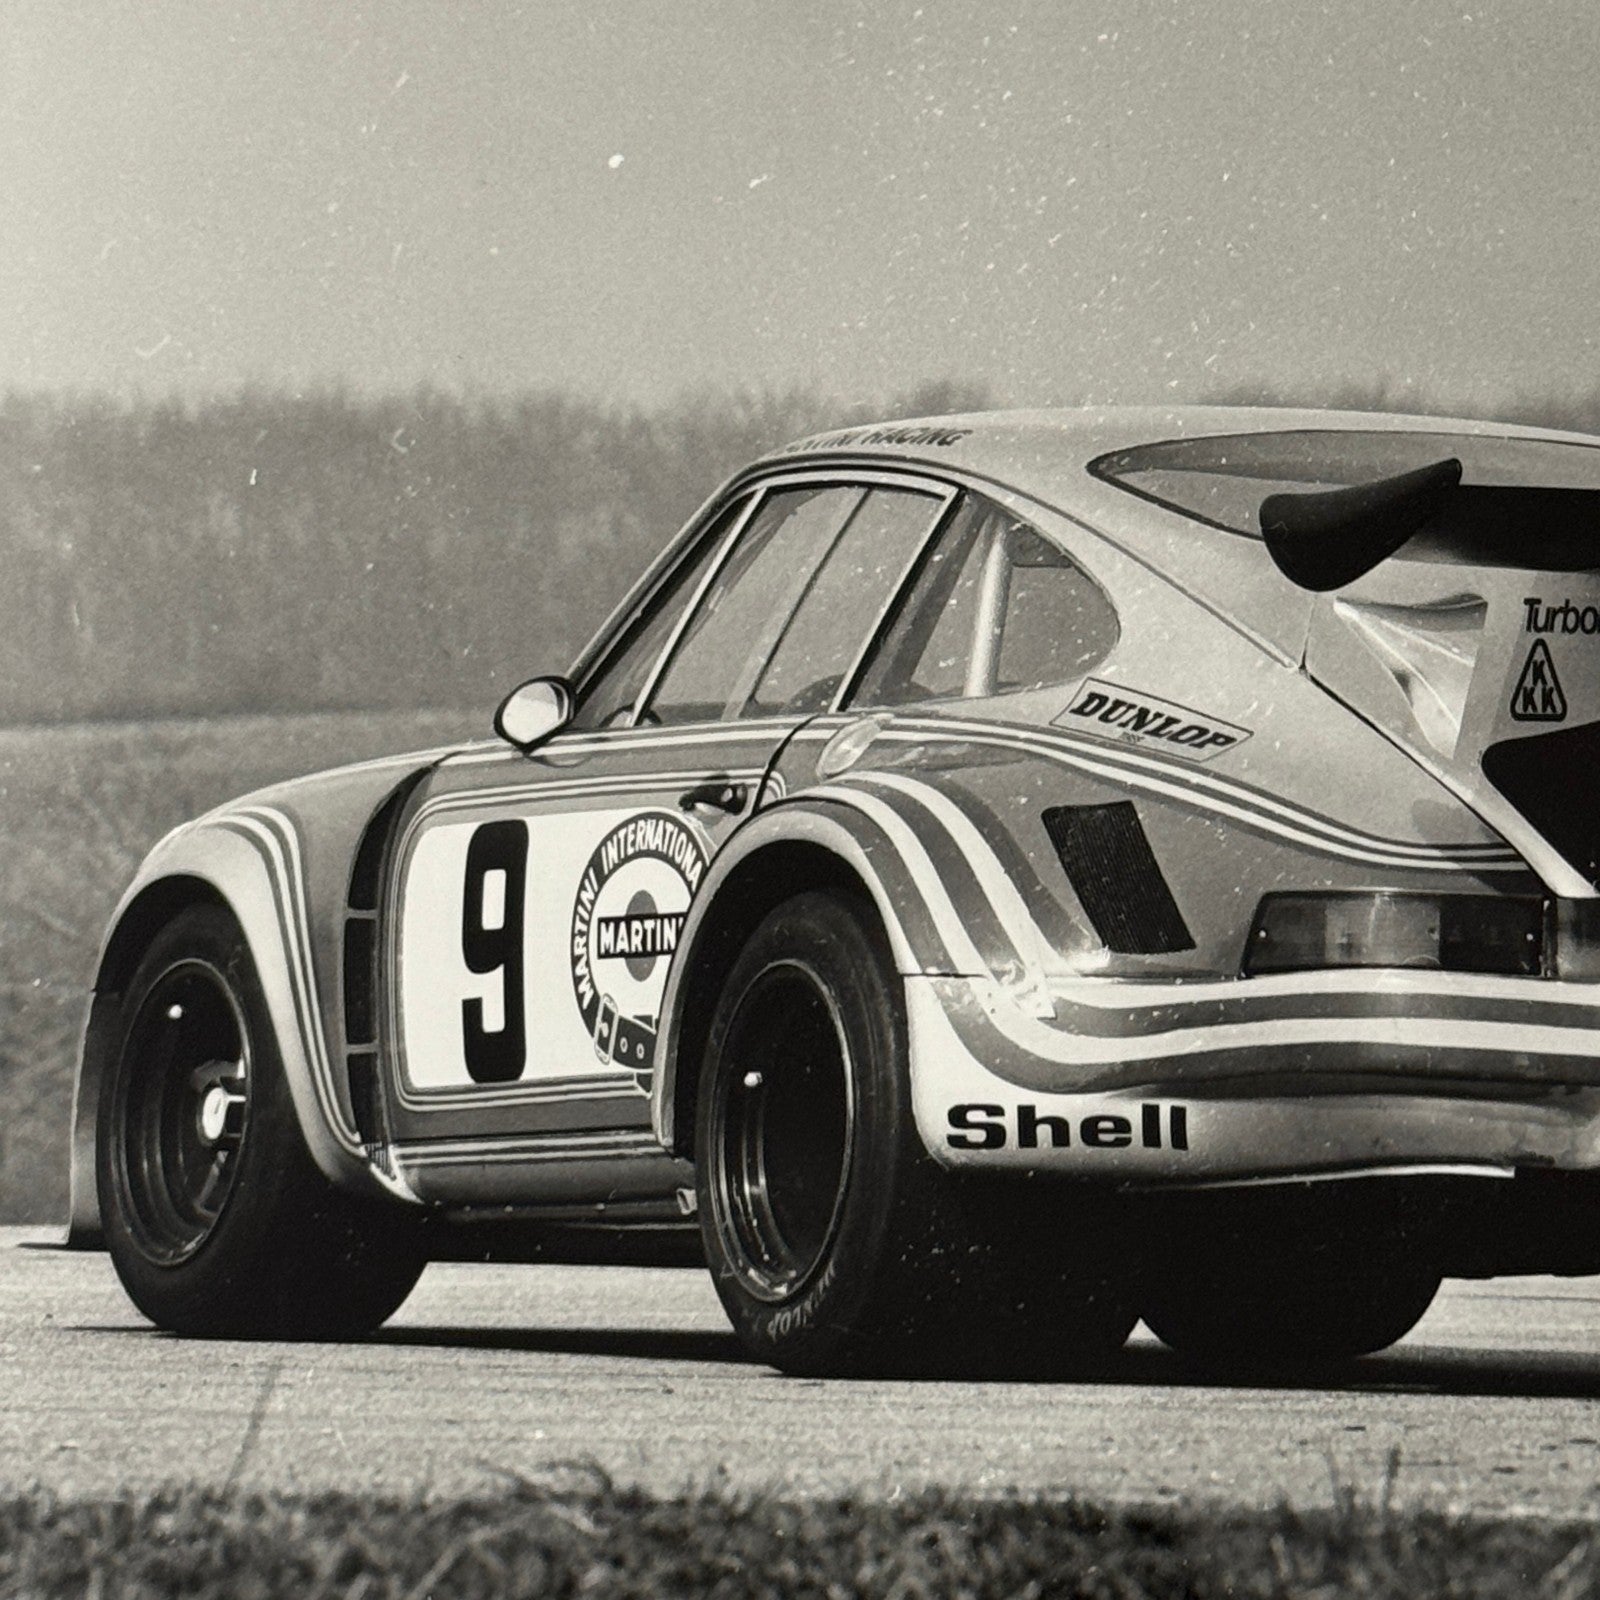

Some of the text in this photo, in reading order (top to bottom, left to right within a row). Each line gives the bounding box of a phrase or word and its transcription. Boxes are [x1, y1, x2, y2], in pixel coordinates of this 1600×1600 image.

[1523, 597, 1600, 635] Turbo
[1069, 691, 1238, 749] DUNLOP
[573, 818, 703, 1011] MARTINI INTERNATIONA
[600, 917, 684, 955] MARTIN
[461, 818, 530, 1084] 9
[946, 1102, 1189, 1151] Shell
